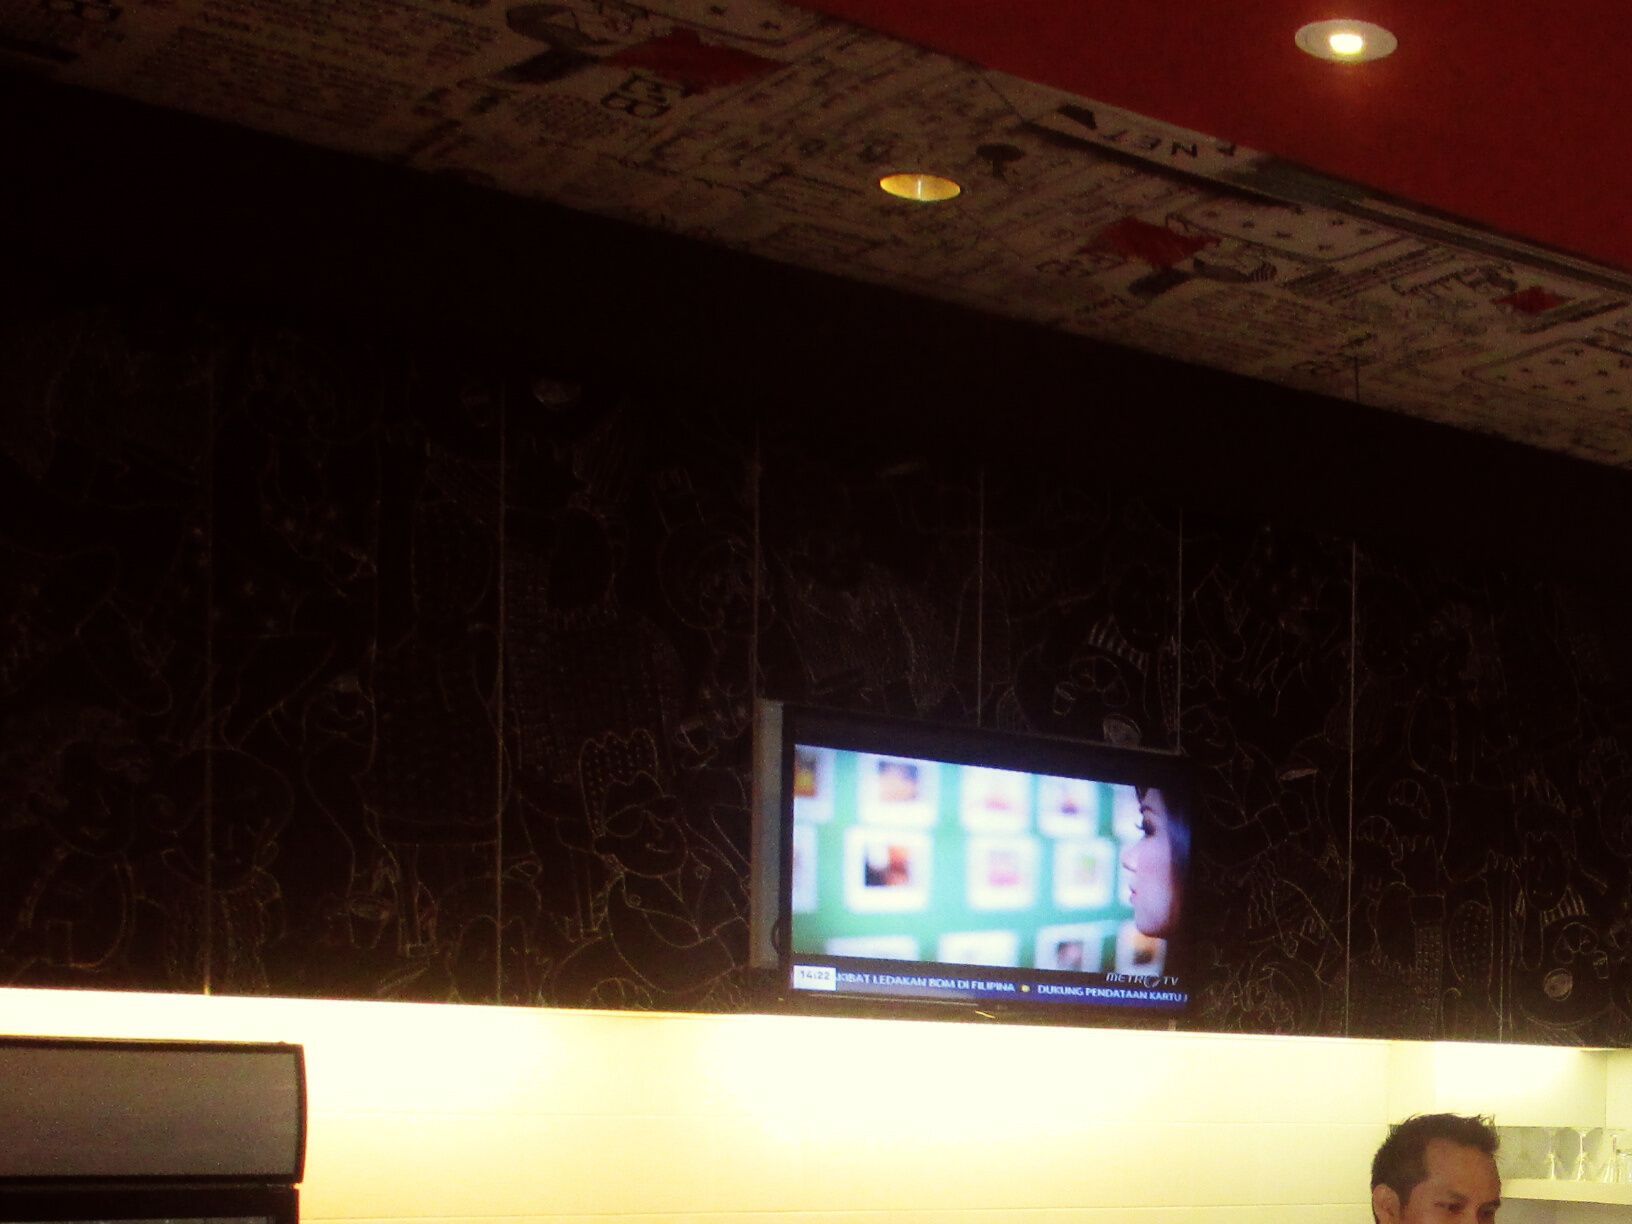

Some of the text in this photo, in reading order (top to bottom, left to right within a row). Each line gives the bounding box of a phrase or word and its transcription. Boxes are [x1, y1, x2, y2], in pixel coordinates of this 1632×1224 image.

[800, 970, 830, 980] 14:22
[1163, 976, 1179, 986] TV
[873, 974, 927, 986] LEDAKAN
[928, 978, 956, 988] BOM
[957, 980, 970, 990] DI
[971, 981, 1015, 992] FILIPINA
[1037, 984, 1084, 996] DUKUNG
[1085, 987, 1148, 1000] PENDATAAN
[1149, 991, 1182, 1002] KARTU
